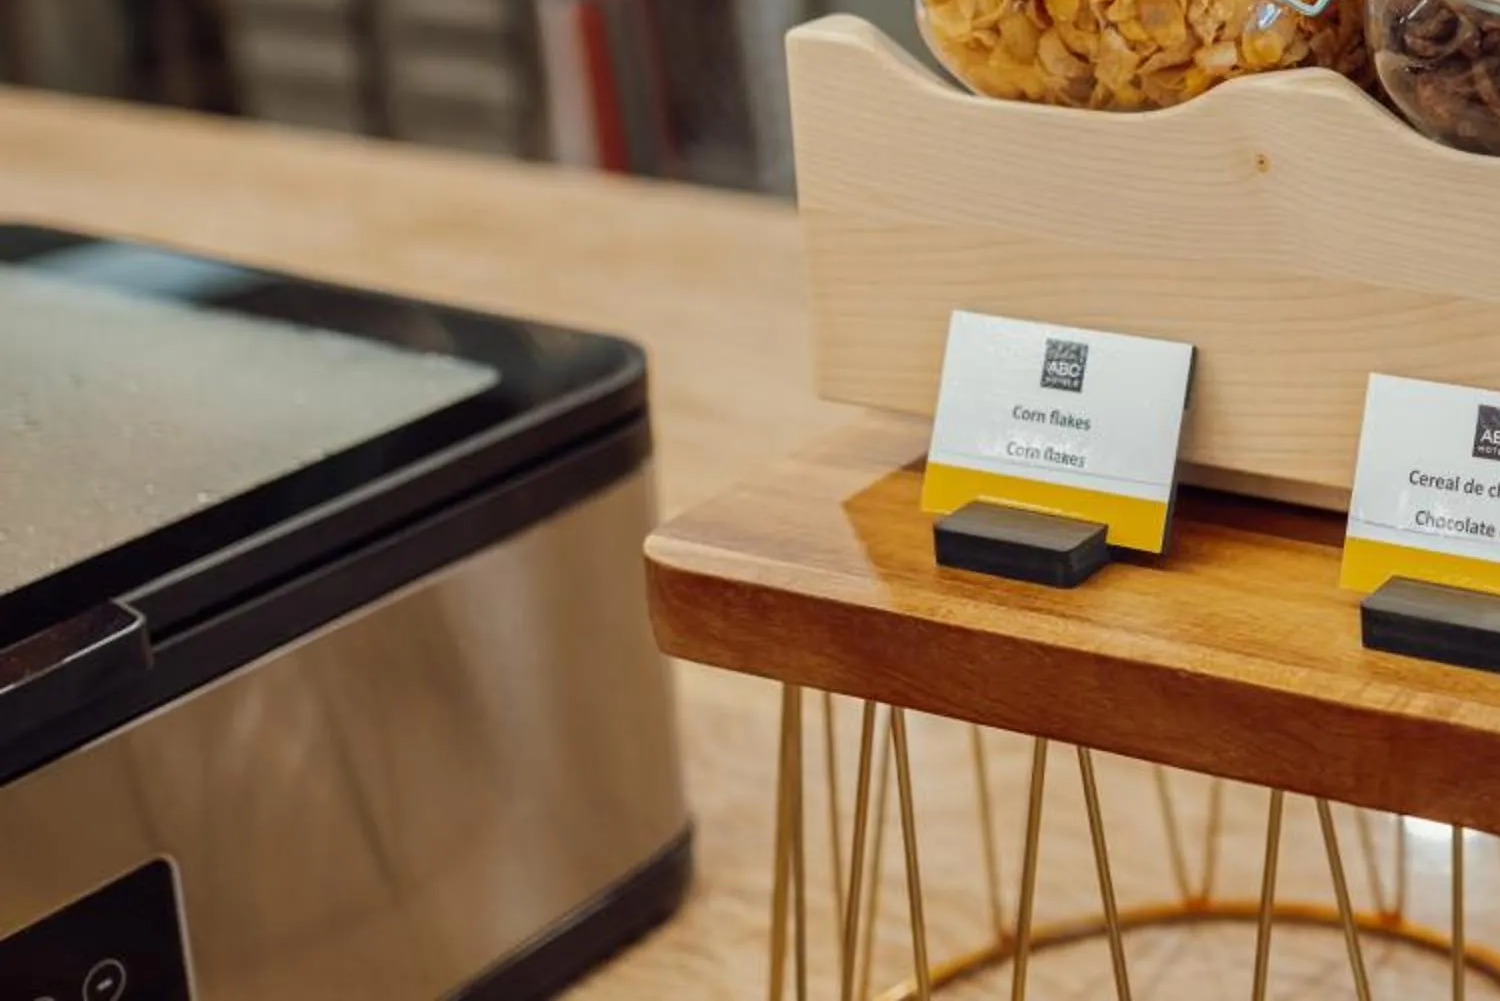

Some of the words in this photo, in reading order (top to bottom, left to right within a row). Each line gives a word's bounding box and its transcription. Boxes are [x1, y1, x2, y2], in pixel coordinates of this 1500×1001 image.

[1047, 360, 1081, 378] ABC
[1012, 405, 1045, 423] Corn
[1049, 410, 1091, 431] flakes
[1007, 441, 1041, 460] Corn
[1044, 446, 1085, 468] flakes
[1409, 470, 1460, 491] Cereal
[1463, 479, 1484, 495] de
[1415, 510, 1496, 537] Chocolate
